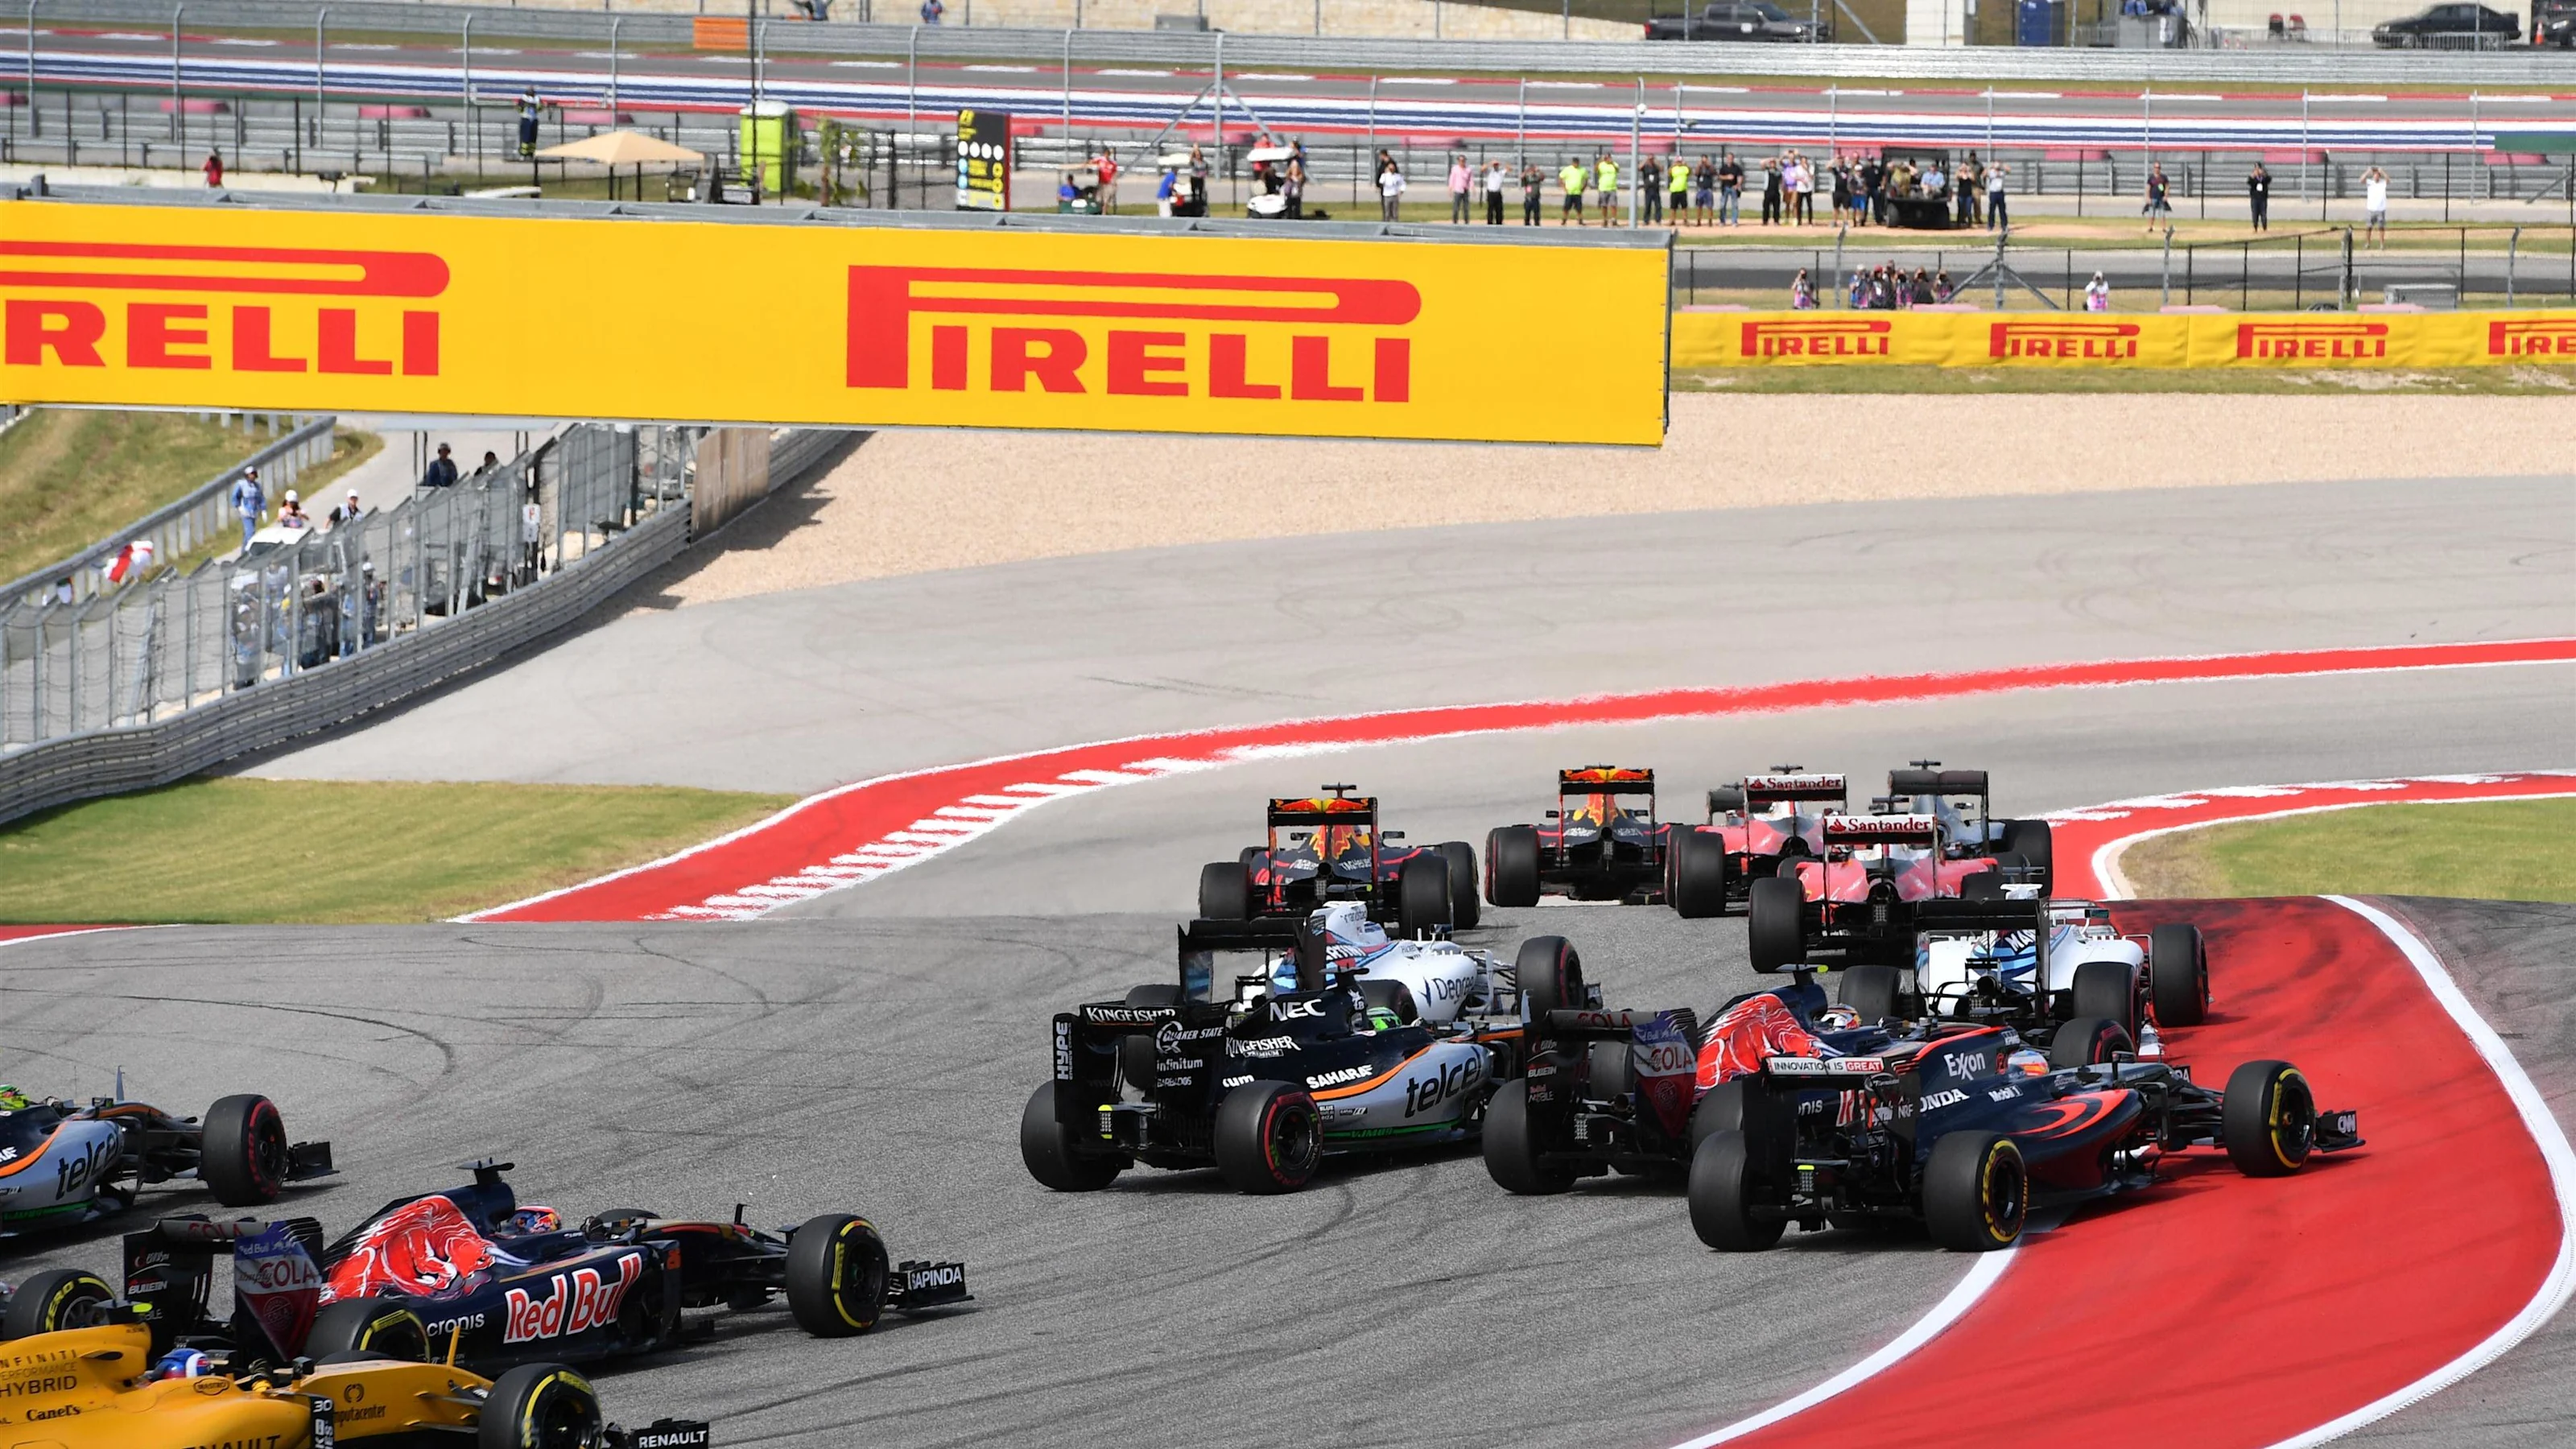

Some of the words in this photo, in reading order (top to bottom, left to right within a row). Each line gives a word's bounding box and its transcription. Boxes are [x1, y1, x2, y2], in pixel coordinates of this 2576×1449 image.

[847, 265, 1421, 402] PIRELLI
[1741, 321, 1891, 356] PIRELLI
[1990, 323, 2140, 357] PIRELLI
[2237, 323, 2388, 358] PIRELLI
[2488, 320, 2576, 356] PIRE
[1766, 777, 1842, 790] Santander
[1847, 817, 1931, 832] Santander
[1269, 998, 1327, 1022] NEC
[1577, 1012, 1633, 1029] COLA
[1199, 1026, 1224, 1039] STATE
[1056, 1021, 1069, 1080] HYPE
[1224, 1035, 1302, 1059] KINGFISHER
[1156, 1057, 1203, 1072] infinitum
[1650, 1046, 1694, 1073] COLA
[1773, 1061, 1831, 1071] INNOVATION
[1835, 1062, 1843, 1071] IS
[1846, 1062, 1881, 1071] GREAT
[1943, 1052, 1986, 1081] Exxon
[1306, 1065, 1372, 1089] SAHARA
[1404, 1049, 1481, 1118] telcel
[1919, 1088, 1970, 1113] ONDA
[1988, 1088, 2014, 1103] Mobil
[2337, 1113, 2356, 1133] CNN
[259, 1259, 318, 1290] COLA
[910, 1265, 964, 1290] SAPINDA
[127, 1280, 169, 1295] BULLETIN
[503, 1274, 568, 1344] Red
[566, 1252, 643, 1335] Bull
[426, 1312, 485, 1338] cronis
[0, 1348, 78, 1368] NFINITI
[1, 1361, 78, 1381] ERFORMANCE
[26, 1404, 82, 1422] Canel's
[312, 1399, 333, 1413] 30
[334, 1404, 386, 1427] mputacenter
[638, 1430, 708, 1449] RENAULT
